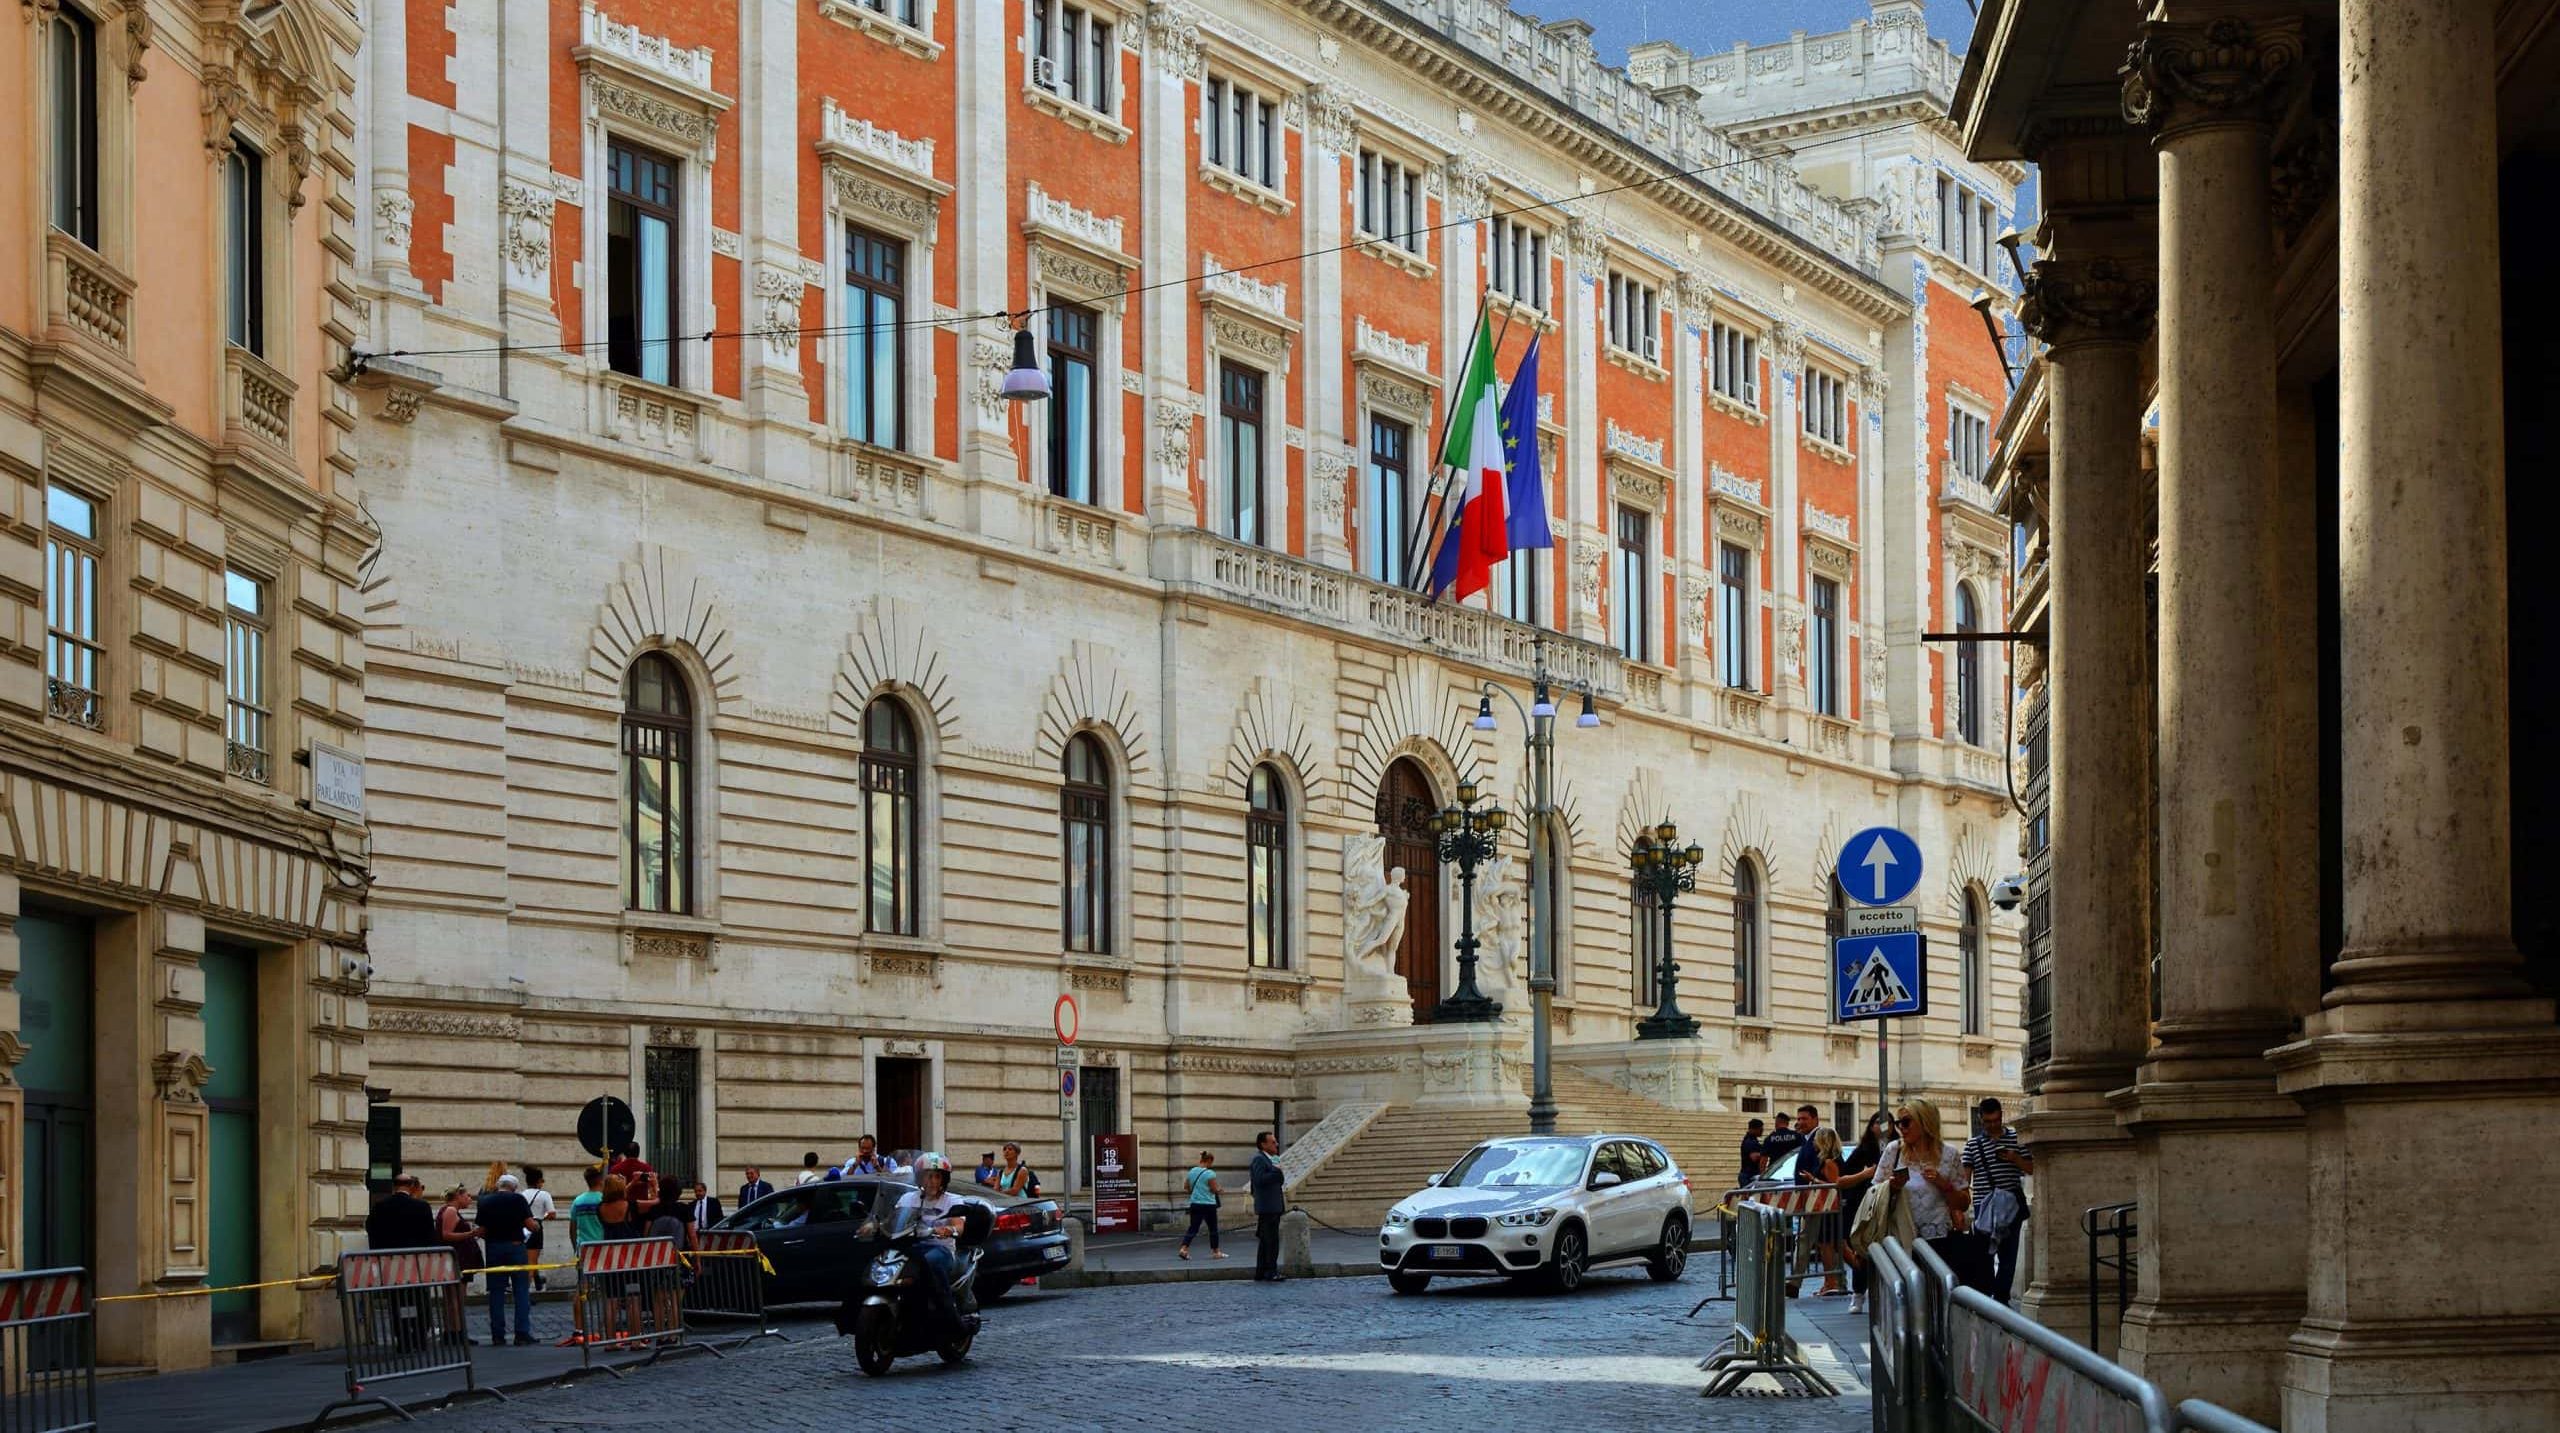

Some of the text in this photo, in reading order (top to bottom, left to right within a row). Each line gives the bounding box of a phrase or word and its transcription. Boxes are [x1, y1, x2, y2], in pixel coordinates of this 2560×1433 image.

[333, 760, 346, 778] VIA
[316, 783, 361, 809] PARLAMENTO
[1859, 911, 1904, 921] eccetto
[1850, 924, 1913, 936] autorizzati
[1771, 1134, 1796, 1143] POLIZIA
[1103, 1149, 1117, 1158] 19
[1103, 1158, 1117, 1166] 19
